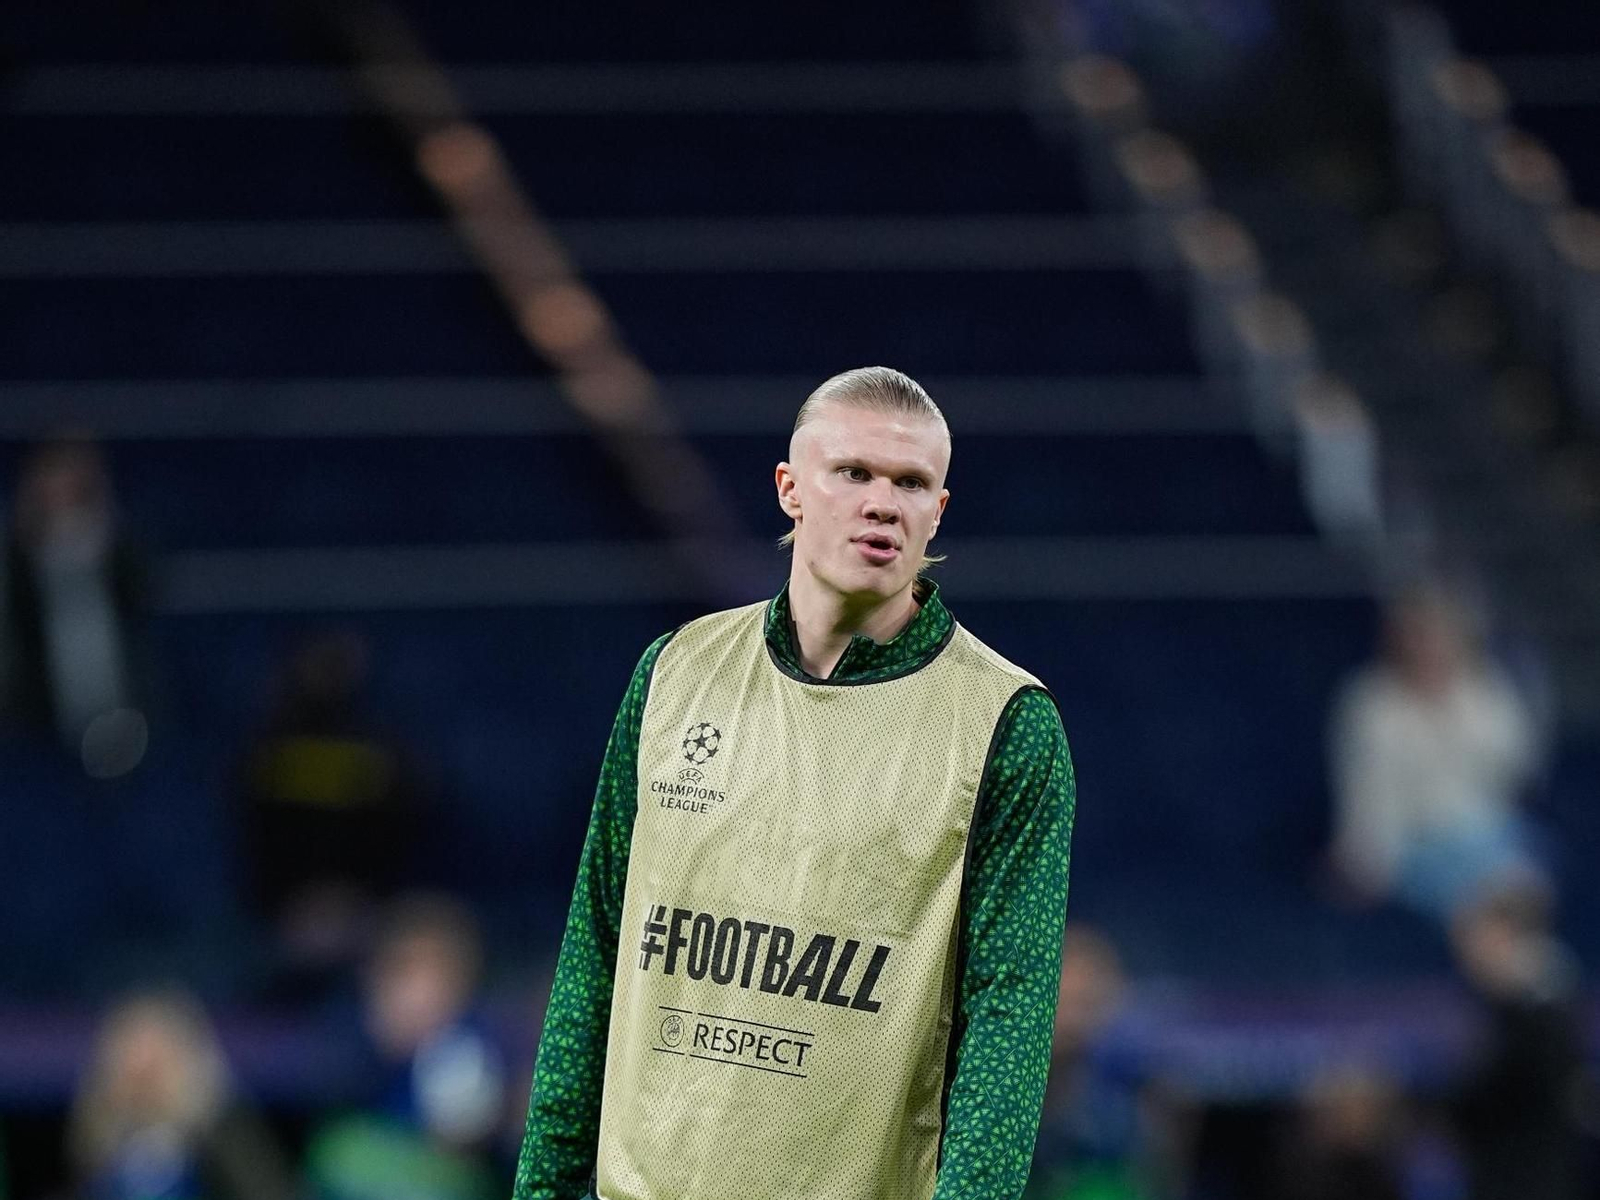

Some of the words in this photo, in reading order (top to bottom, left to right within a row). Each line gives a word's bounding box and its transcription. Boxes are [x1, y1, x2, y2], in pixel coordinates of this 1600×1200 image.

[678, 770, 702, 783] UEFA
[651, 780, 726, 803] CHAMPIONS
[660, 796, 709, 814] LEAGUE
[639, 904, 892, 1014] #FOOTBALL
[693, 1023, 813, 1067] RESPECT
